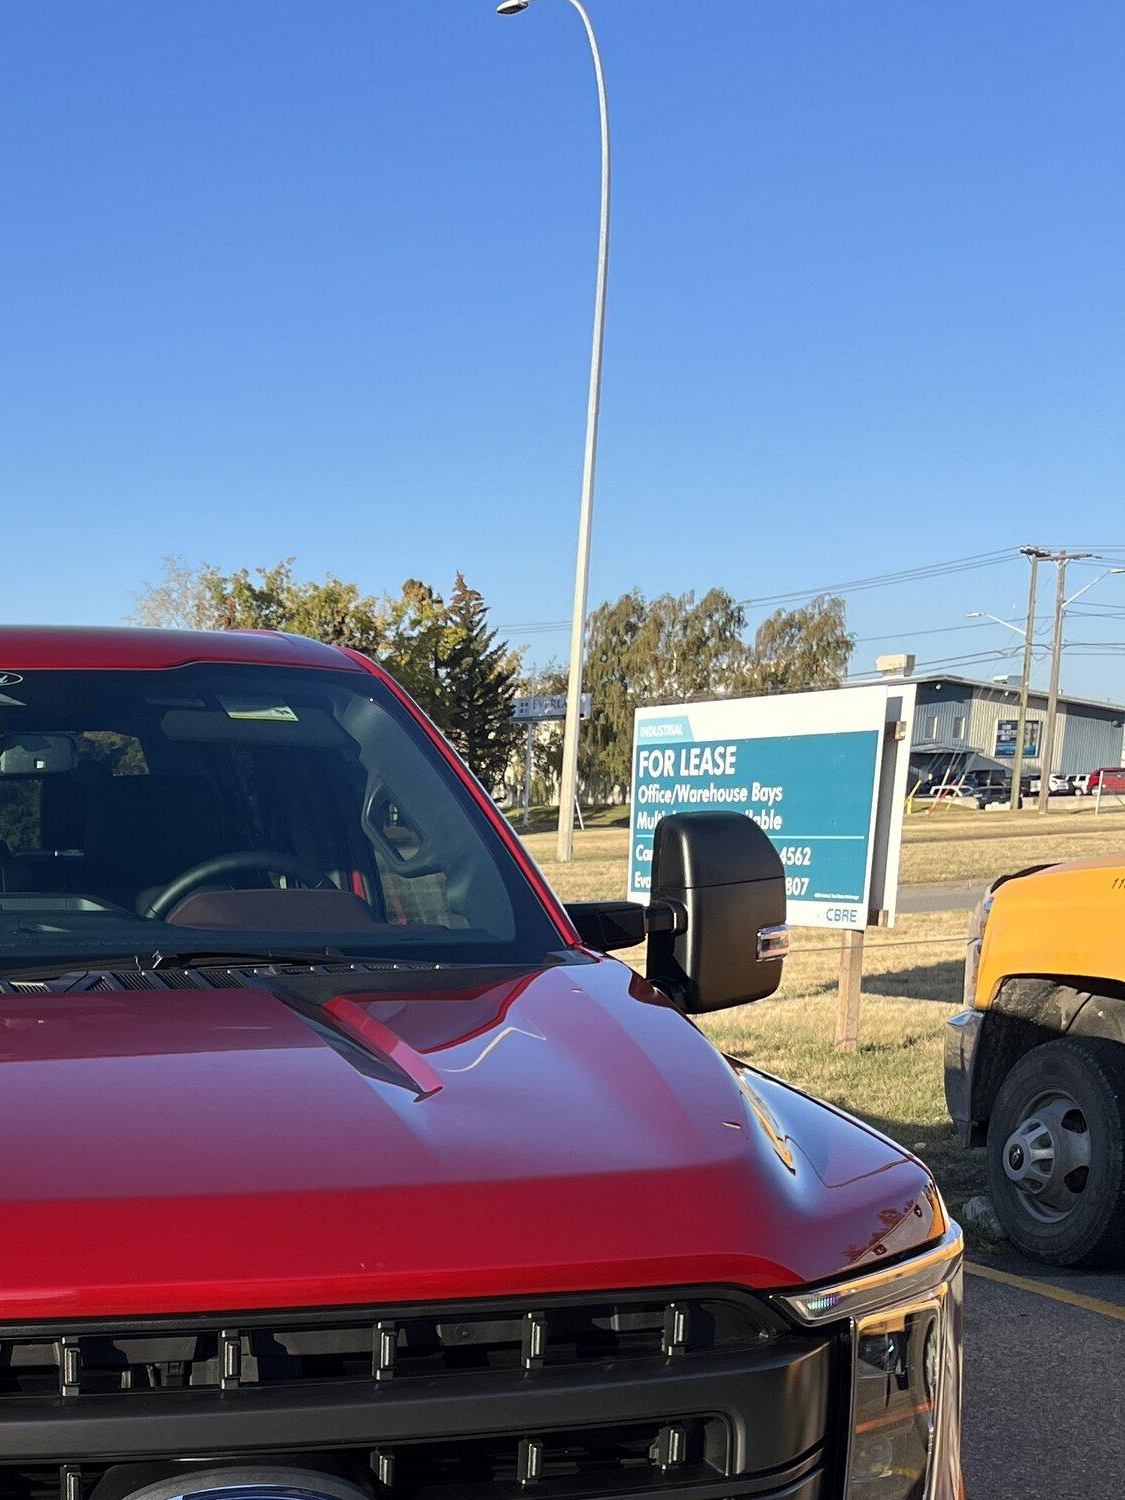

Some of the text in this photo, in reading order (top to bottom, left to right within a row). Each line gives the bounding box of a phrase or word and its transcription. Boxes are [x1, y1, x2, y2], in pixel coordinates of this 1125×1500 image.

[640, 723, 683, 738] INDUSTRIAL
[638, 745, 737, 778] FOR LEASE
[637, 781, 783, 806] Office/Warehouse Bays
[785, 877, 810, 896] 807
[826, 908, 858, 922] CBRE
